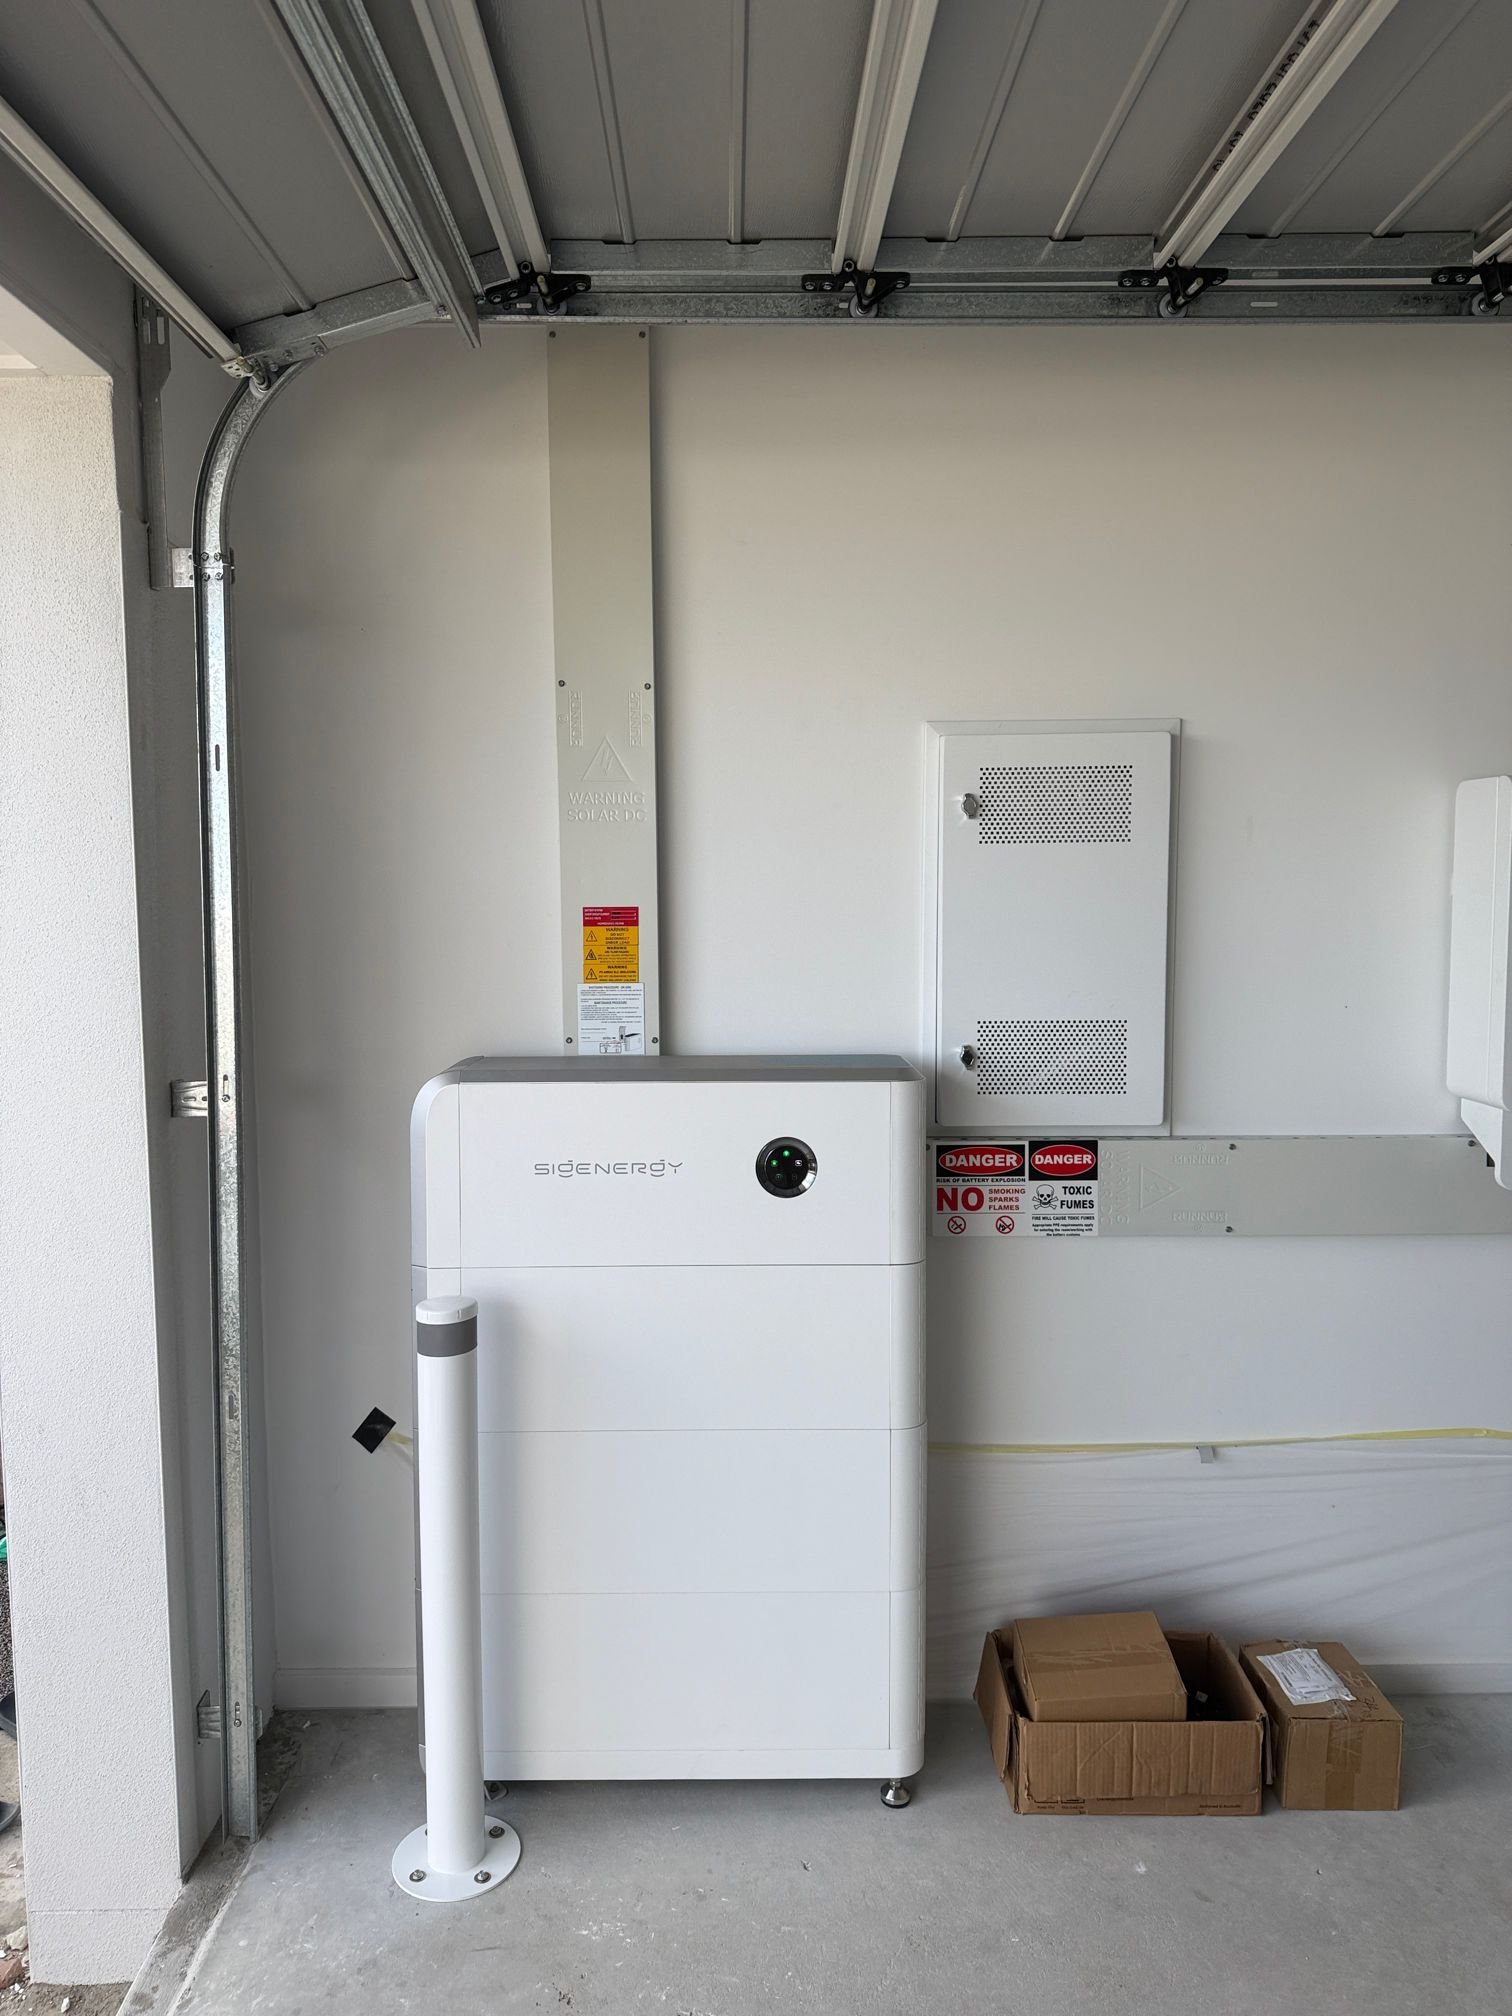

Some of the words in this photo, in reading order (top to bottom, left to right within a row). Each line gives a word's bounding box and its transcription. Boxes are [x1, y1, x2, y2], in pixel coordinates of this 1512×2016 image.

[568, 791, 646, 805] WARNING
[567, 808, 620, 822] SOLAR
[624, 808, 648, 822] DC
[945, 1154, 1018, 1167] DANGER
[1034, 1154, 1092, 1165] DANGER
[1061, 1185, 1093, 1196] TOXIC
[936, 1186, 985, 1212] NO
[1060, 1199, 1095, 1209] FUMES
